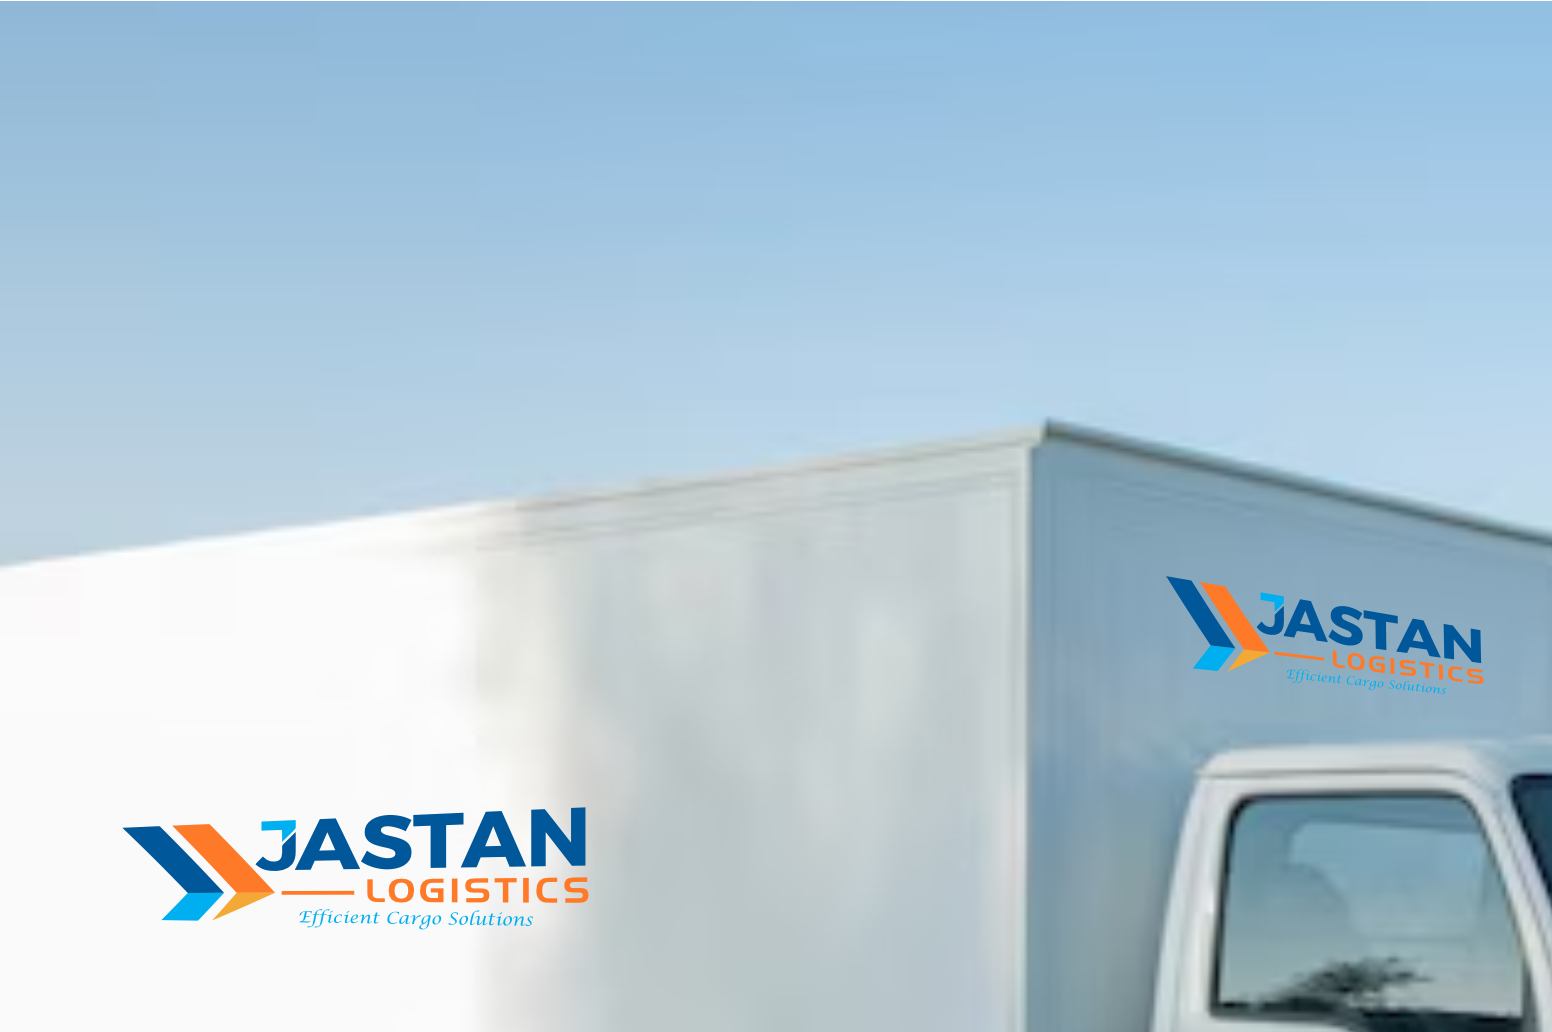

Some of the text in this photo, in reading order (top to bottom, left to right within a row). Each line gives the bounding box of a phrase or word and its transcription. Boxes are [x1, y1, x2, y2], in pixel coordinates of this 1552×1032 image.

[1256, 592, 1482, 664] JASTAN
[1286, 668, 1447, 695] Efficient Cargo Solutions
[1332, 650, 1484, 685] LOGISTICS
[255, 807, 586, 872] JASTAN
[366, 876, 589, 904] LOGISTICS
[299, 909, 534, 930] Efficient Cargo Solutions
